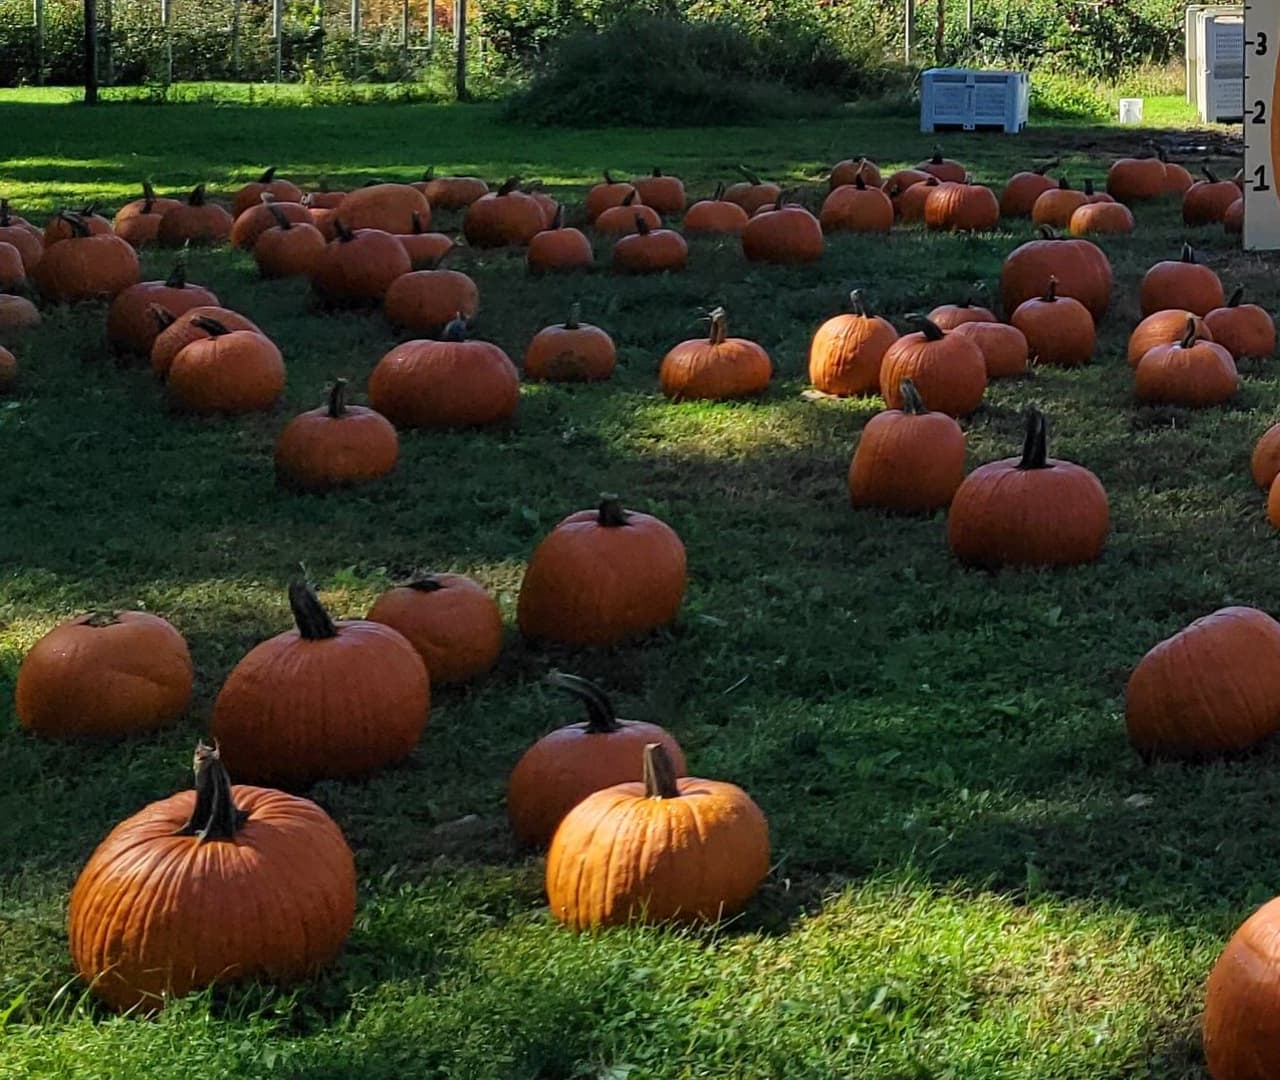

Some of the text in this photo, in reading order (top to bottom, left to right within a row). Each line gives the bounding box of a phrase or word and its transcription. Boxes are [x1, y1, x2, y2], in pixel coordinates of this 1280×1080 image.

[1255, 31, 1268, 56] 3
[1252, 100, 1266, 125] 2
[1252, 164, 1270, 192] 1
